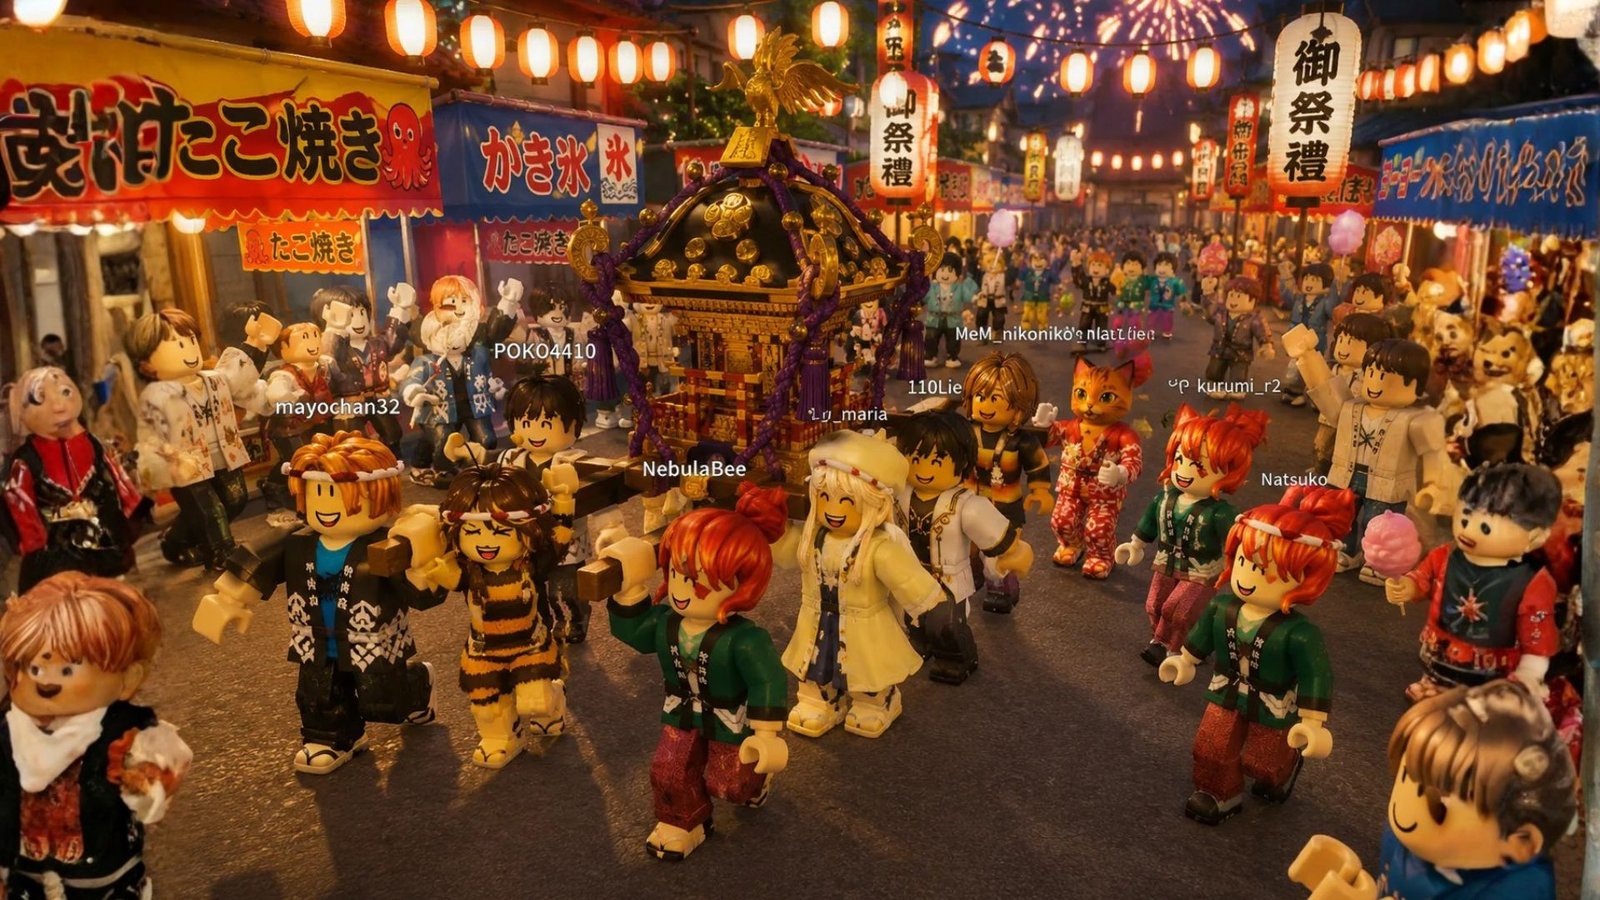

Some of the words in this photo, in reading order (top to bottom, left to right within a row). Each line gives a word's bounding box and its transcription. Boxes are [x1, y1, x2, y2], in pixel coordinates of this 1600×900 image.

[1284, 40, 1340, 182] 御祭禮
[480, 126, 591, 197] かき氷
[605, 133, 632, 181] 氷
[270, 230, 355, 264] たこ焼き
